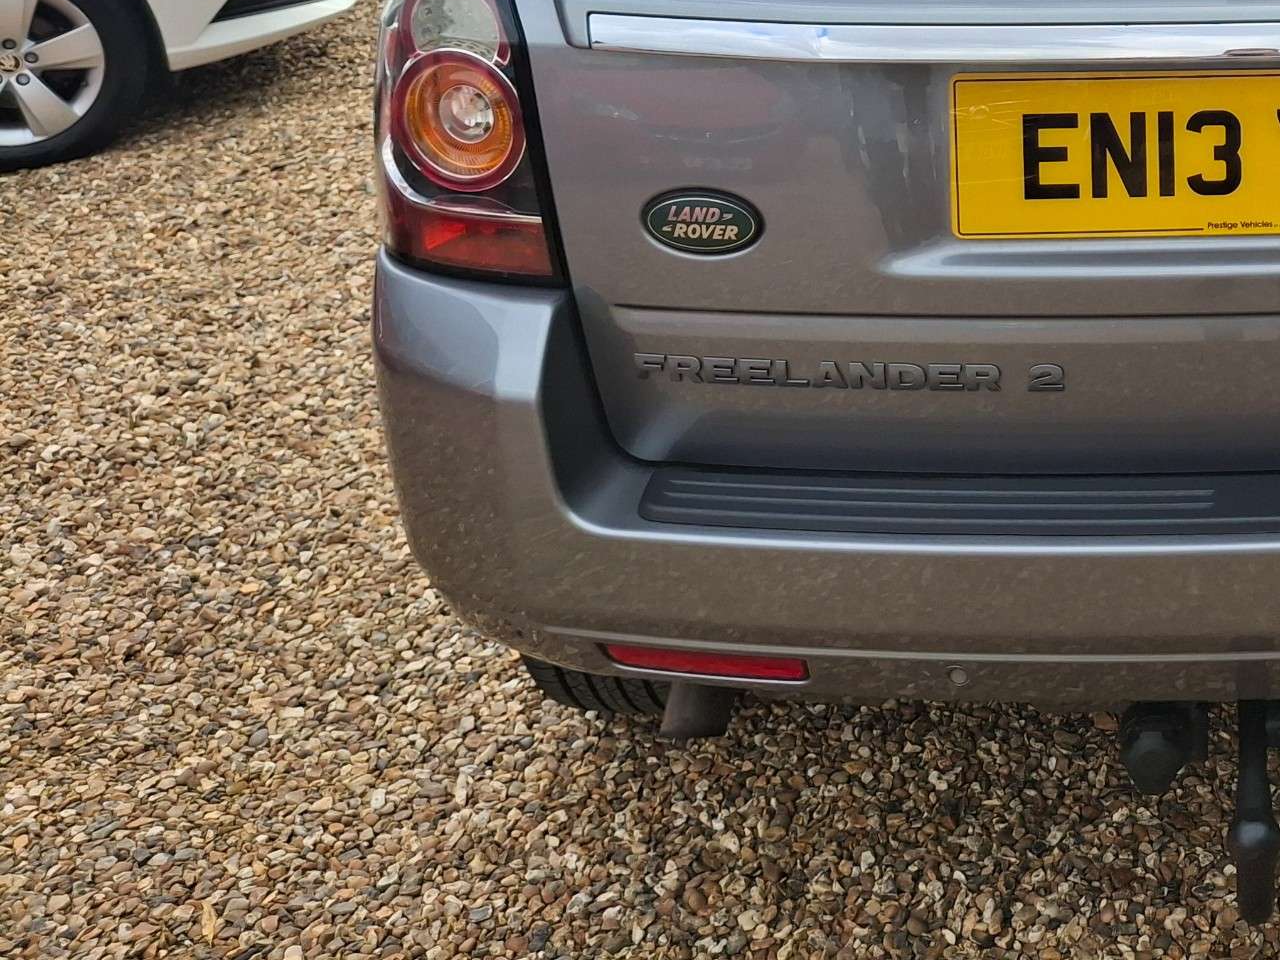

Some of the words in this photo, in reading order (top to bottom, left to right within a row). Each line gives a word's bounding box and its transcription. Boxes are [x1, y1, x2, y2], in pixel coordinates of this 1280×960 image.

[1022, 109, 1243, 200] EN13
[667, 206, 721, 223] LAND
[673, 223, 739, 240] ROVER
[1207, 221, 1238, 231] Prestige
[1240, 220, 1273, 229] Vehicles
[633, 352, 1002, 393] FREELANDER
[1027, 362, 1066, 393] 2
